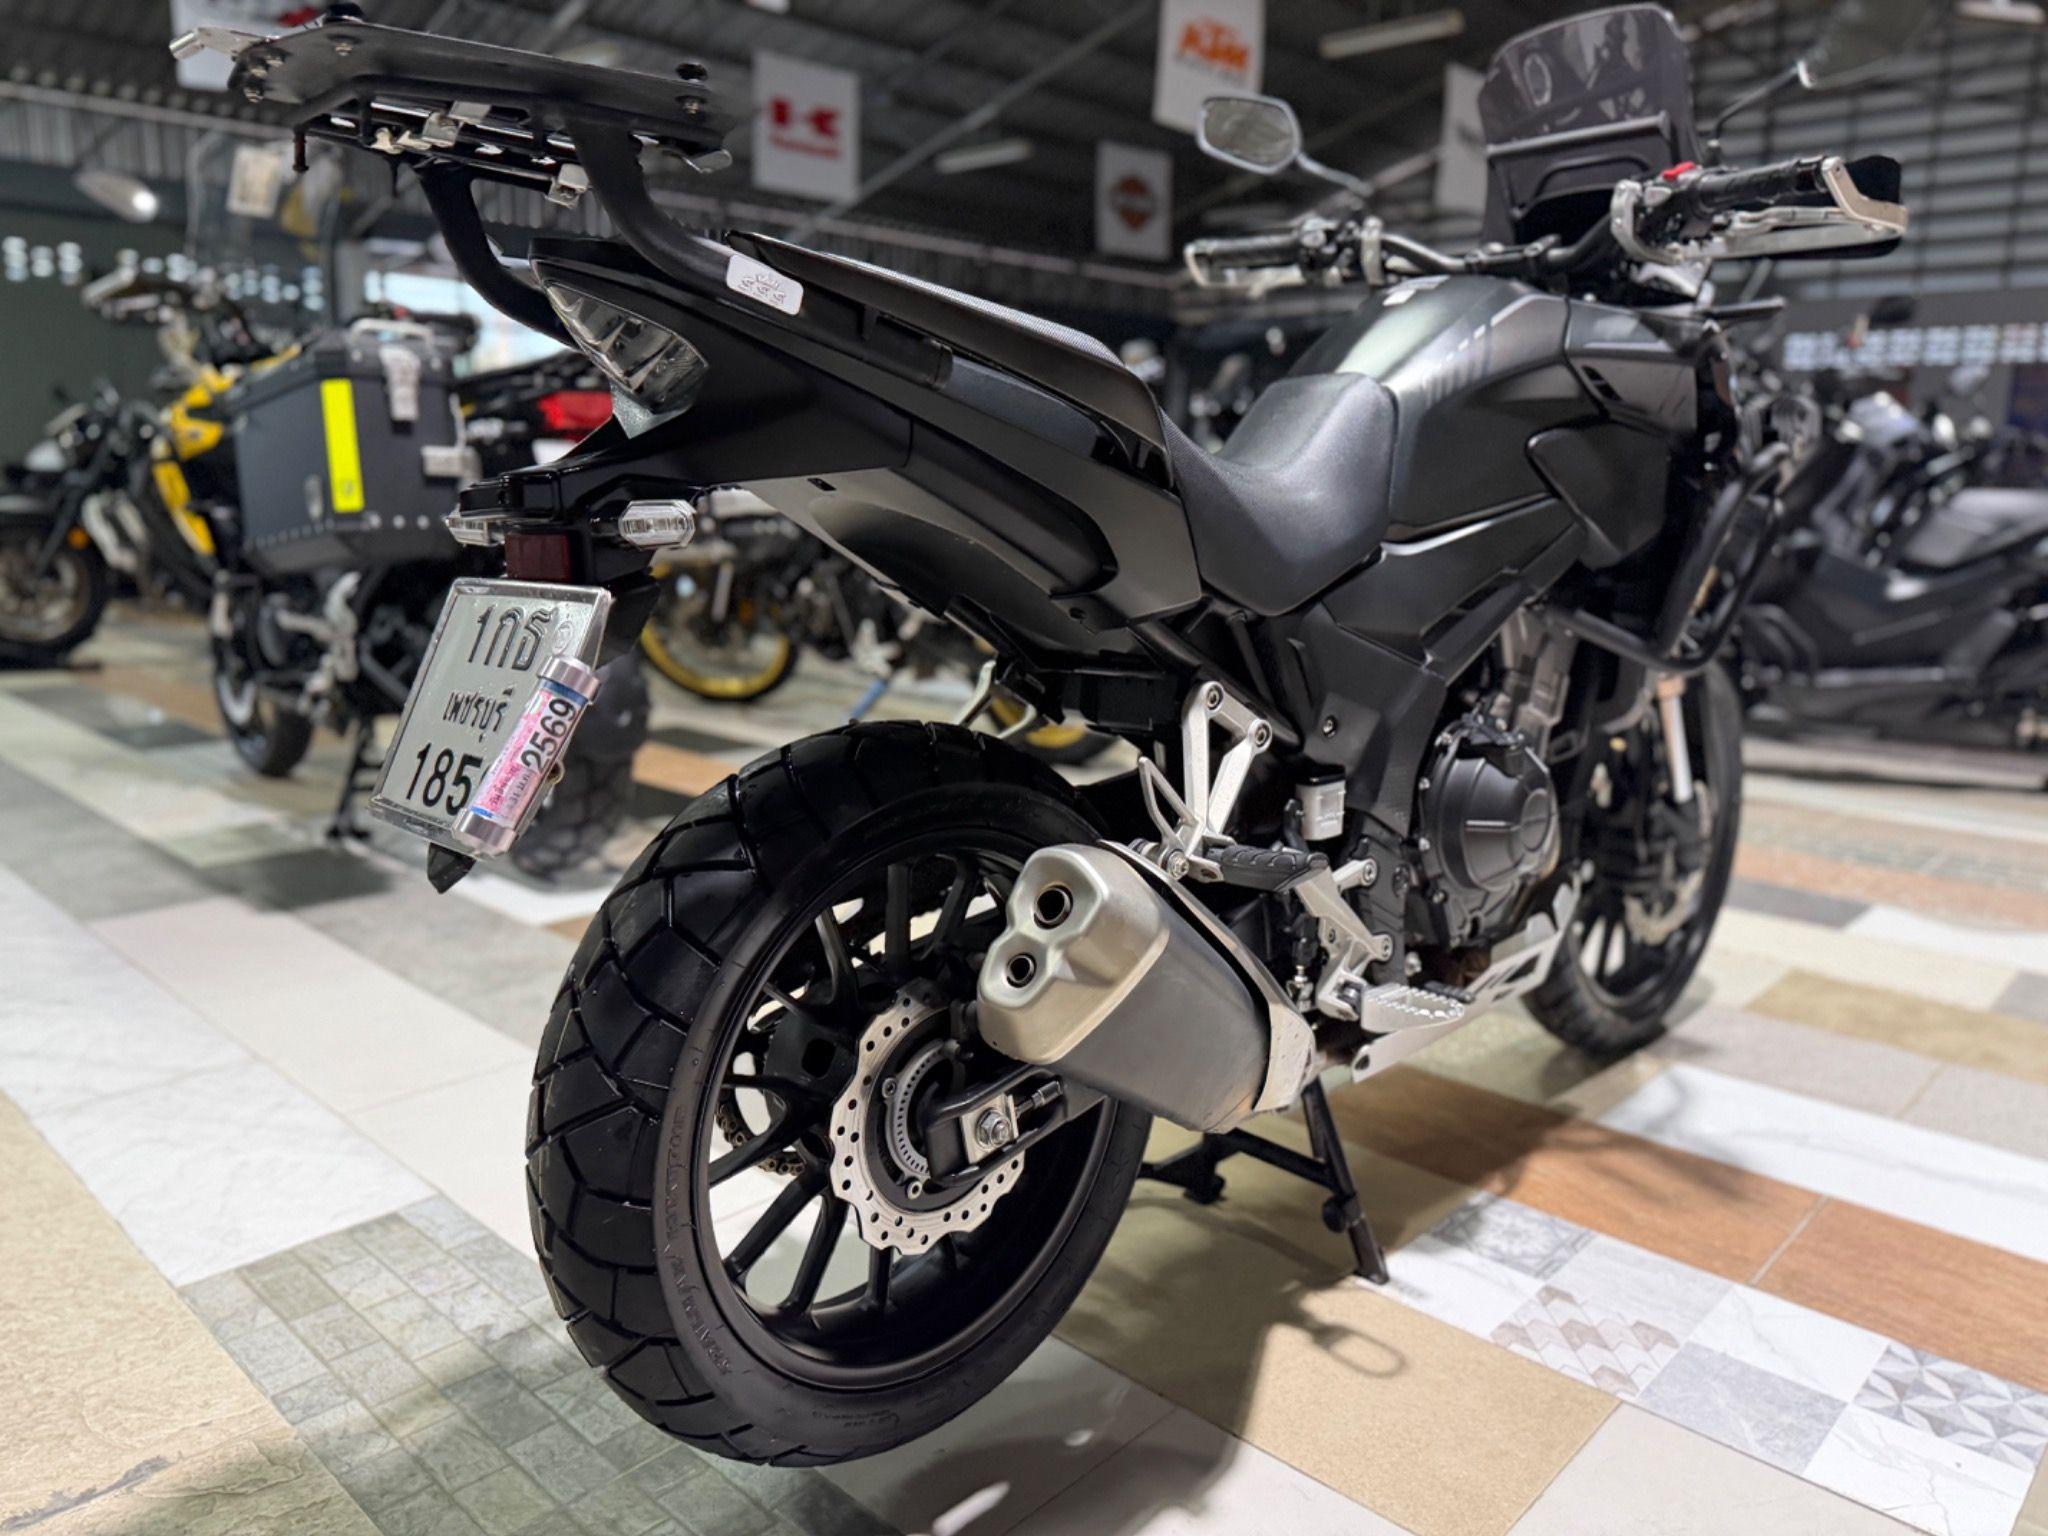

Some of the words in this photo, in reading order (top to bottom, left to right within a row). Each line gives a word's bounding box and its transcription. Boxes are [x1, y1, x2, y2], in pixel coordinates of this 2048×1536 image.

[468, 605, 558, 671] 1กธ
[442, 684, 515, 744] เพชรบุรี
[521, 699, 577, 775] 2569
[406, 743, 492, 816] 185
